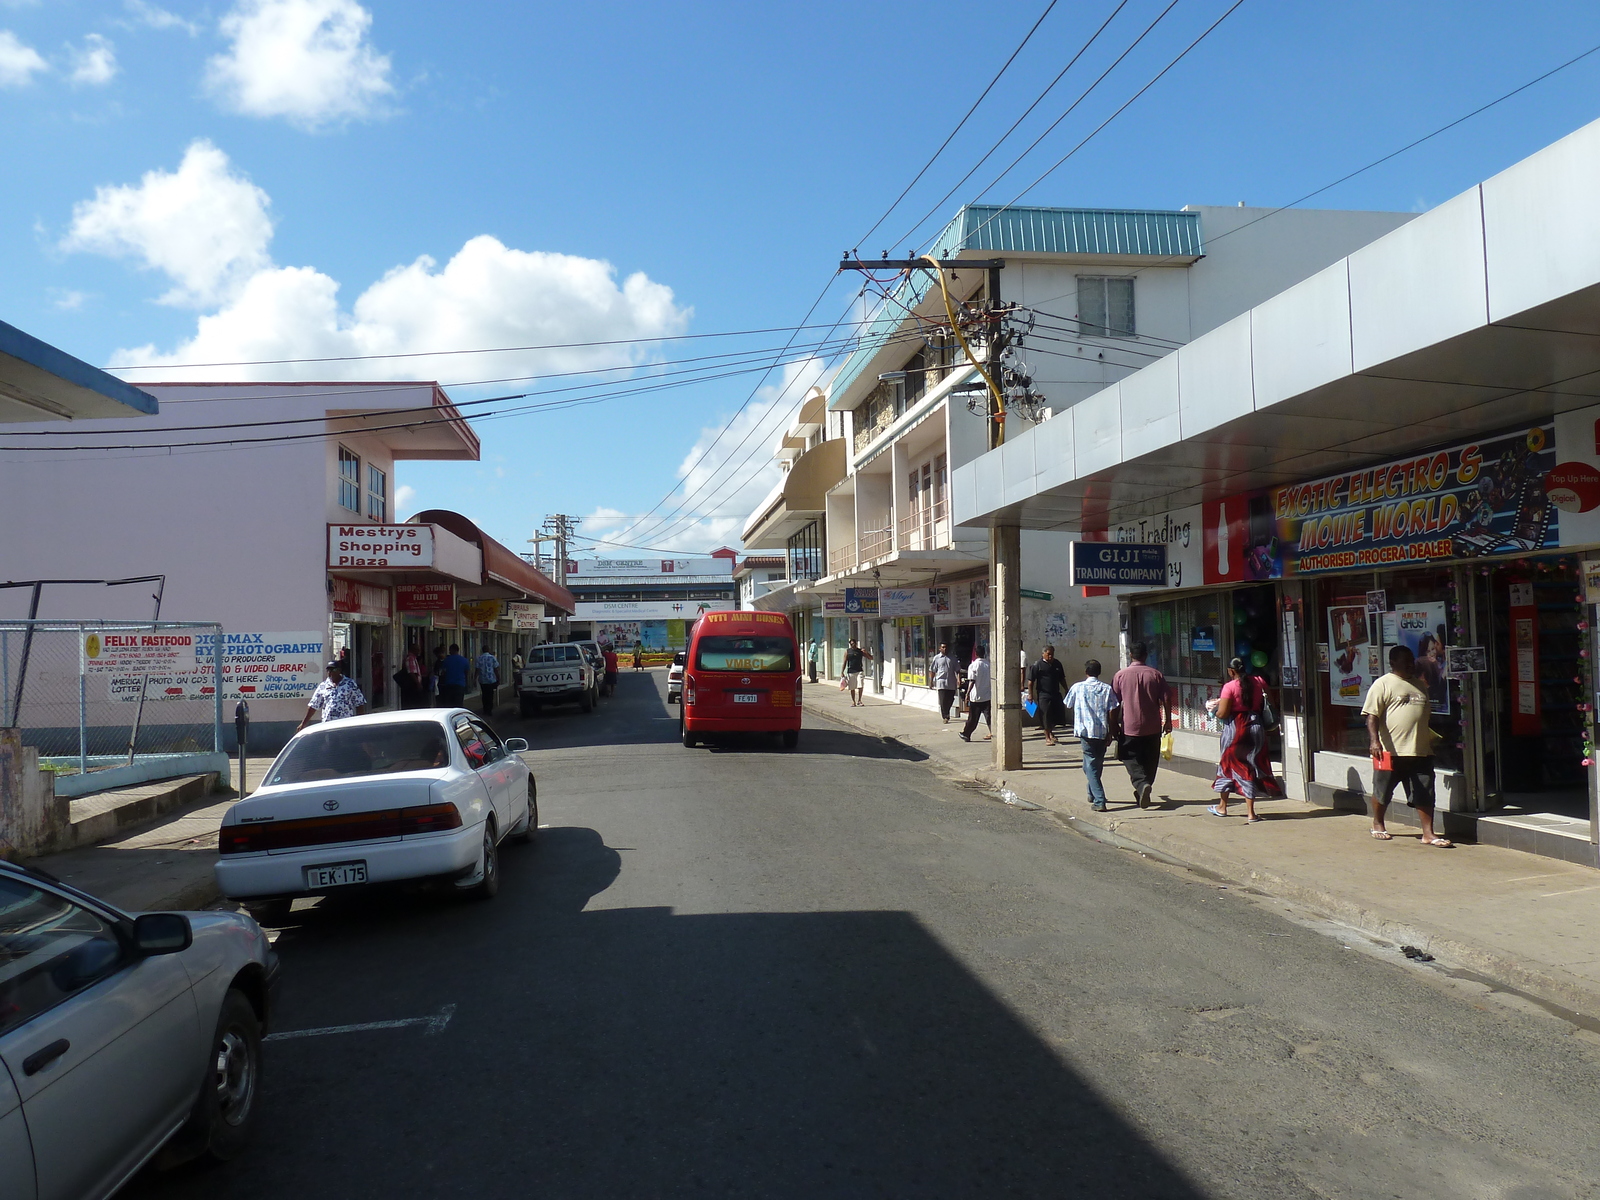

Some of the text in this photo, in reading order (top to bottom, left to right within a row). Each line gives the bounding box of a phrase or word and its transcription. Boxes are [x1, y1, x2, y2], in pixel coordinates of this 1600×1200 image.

[1276, 445, 1483, 520] EXOTIC ELECTRO &
[1551, 475, 1566, 484] Top
[1567, 475, 1578, 484] Up
[1551, 494, 1576, 503] Digicel
[1298, 494, 1458, 552] MOVIE WORLD
[339, 527, 417, 540] Mestrys
[1139, 515, 1190, 548] Trading
[340, 542, 421, 556] Shopping
[339, 556, 388, 566] Plaza
[1099, 549, 1139, 562] GIJI
[1299, 539, 1452, 572] AUTHORISED PROCERA DEALER
[1076, 567, 1116, 579] TRADING
[1119, 568, 1164, 580] COMPANY
[1401, 620, 1427, 628] GHOST
[105, 636, 191, 646] FELIX FASTFOOD
[227, 643, 323, 655] PHOTOGRAPHY
[235, 665, 242, 673] &
[726, 659, 767, 668] VMBCL
[528, 673, 573, 683] TOYOTA
